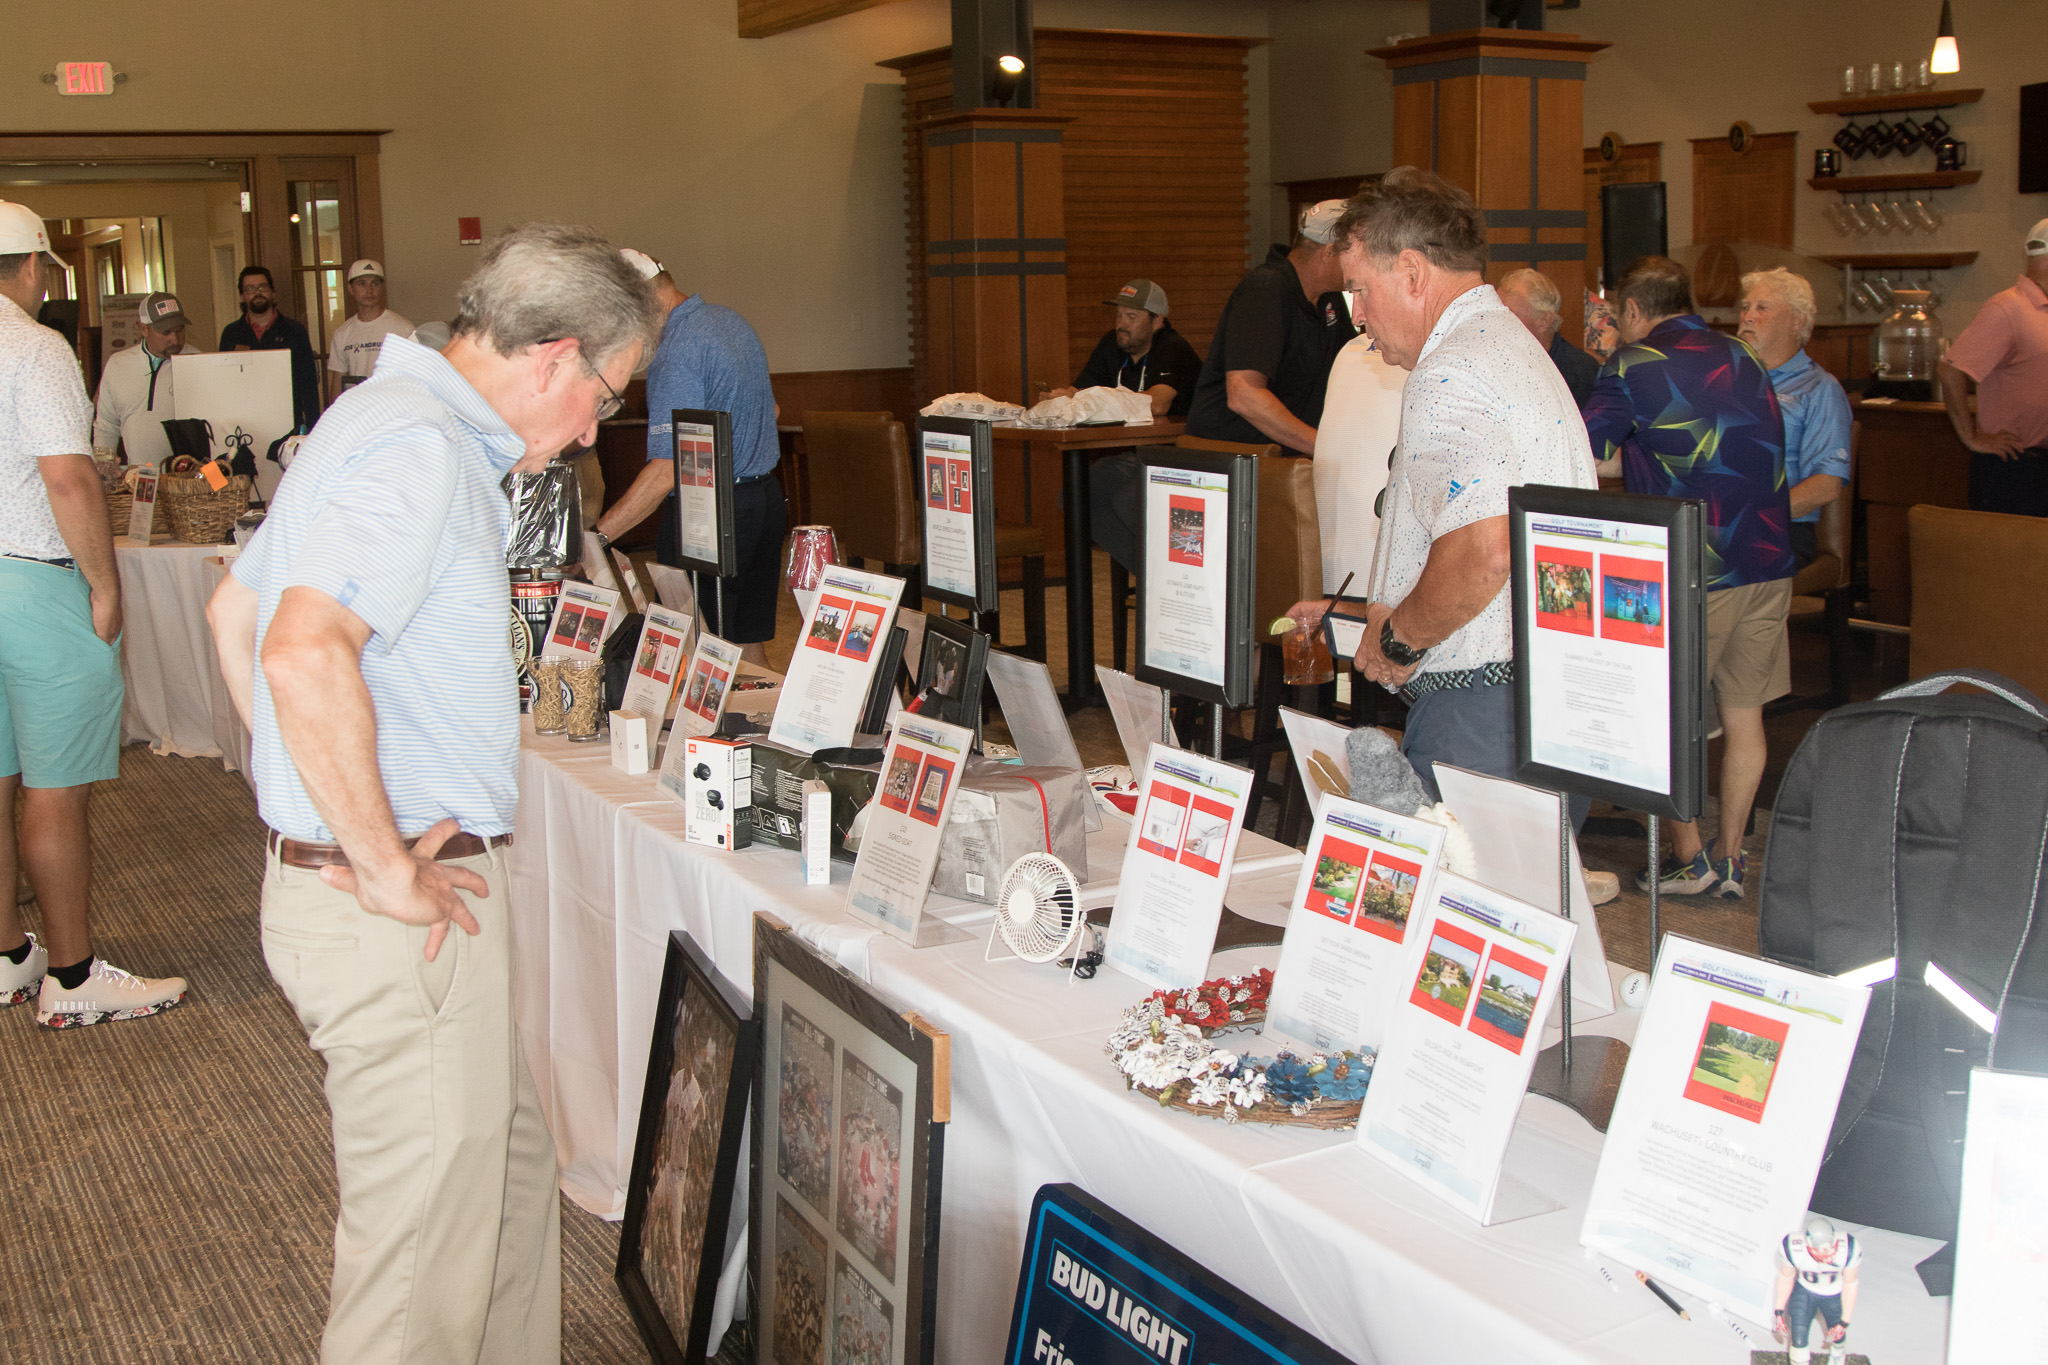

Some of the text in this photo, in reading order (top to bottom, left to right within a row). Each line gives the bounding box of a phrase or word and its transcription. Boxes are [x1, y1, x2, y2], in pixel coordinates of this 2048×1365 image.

[65, 62, 105, 93] EXIT
[1567, 519, 1603, 529] TOURNAMENT
[696, 805, 717, 823] ZERO
[1701, 962, 1720, 973] GOLF
[1722, 967, 1768, 986] TOURNAMENT
[1708, 1124, 1724, 1137] 127
[1747, 1156, 1774, 1173] CLUB
[1052, 1248, 1189, 1365] BUD LIGHT
